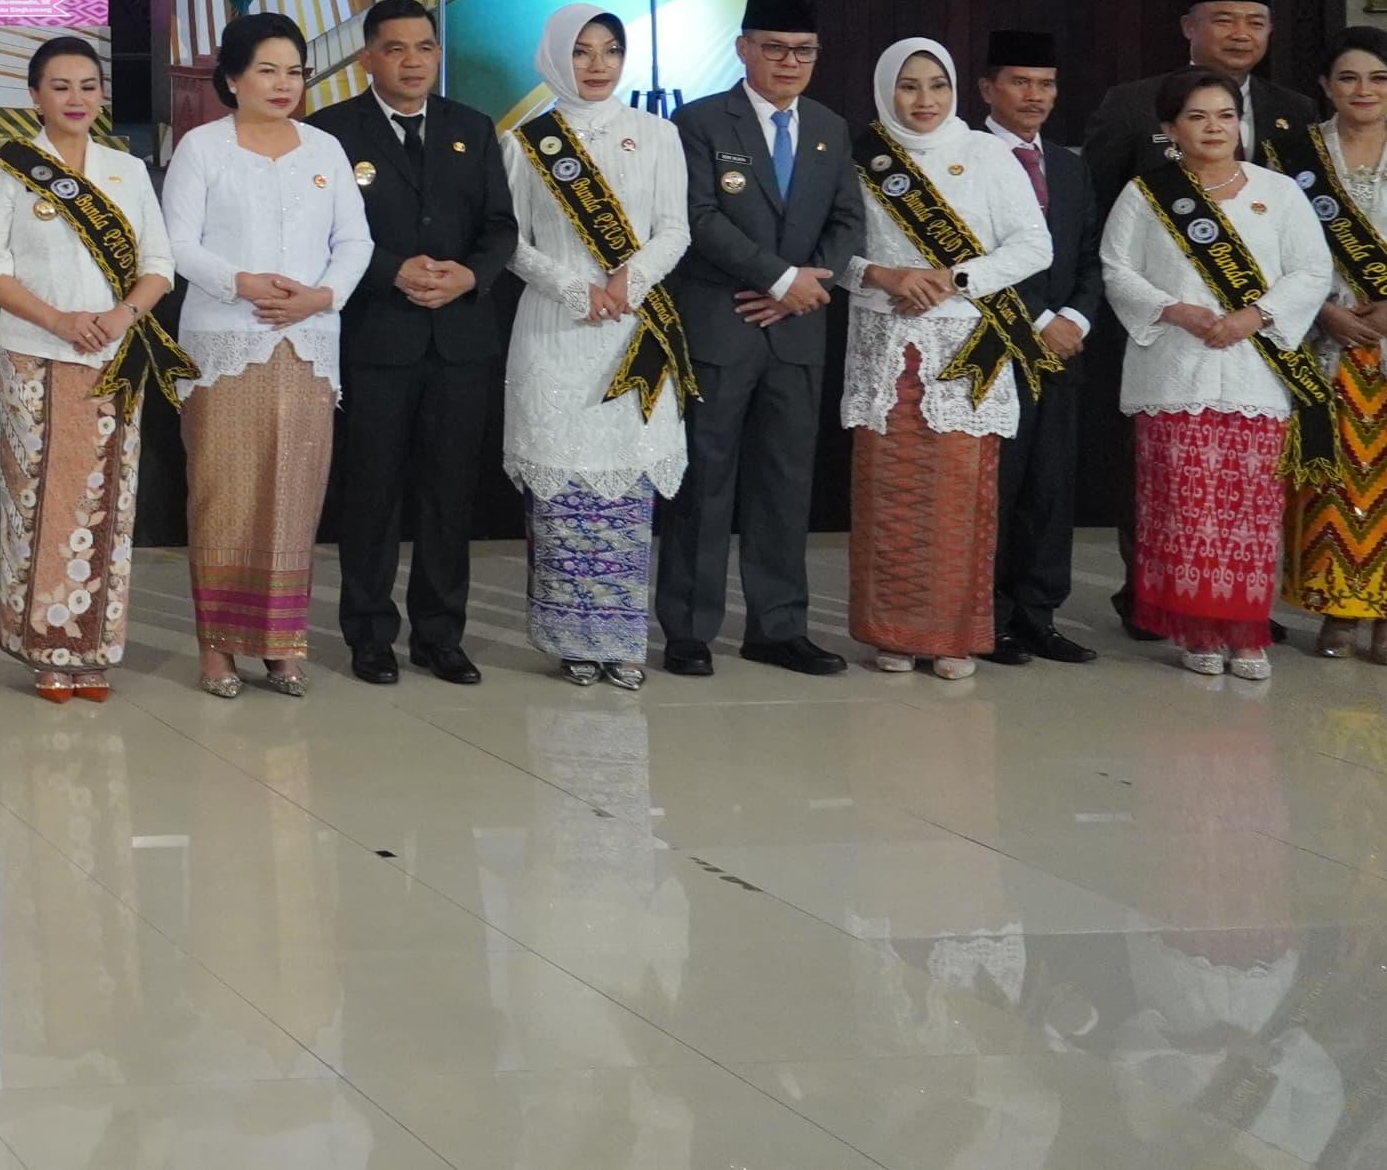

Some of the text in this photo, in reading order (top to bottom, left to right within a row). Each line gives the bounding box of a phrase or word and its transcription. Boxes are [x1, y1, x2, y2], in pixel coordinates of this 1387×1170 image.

[74, 193, 136, 270] Bunda PAUD
[570, 177, 607, 214] Bunda
[593, 212, 627, 251] PAUD
[901, 189, 934, 223] Bunda
[926, 218, 963, 253] PAUD
[1329, 217, 1375, 263] Bunda
[1207, 241, 1254, 290] Bunda
